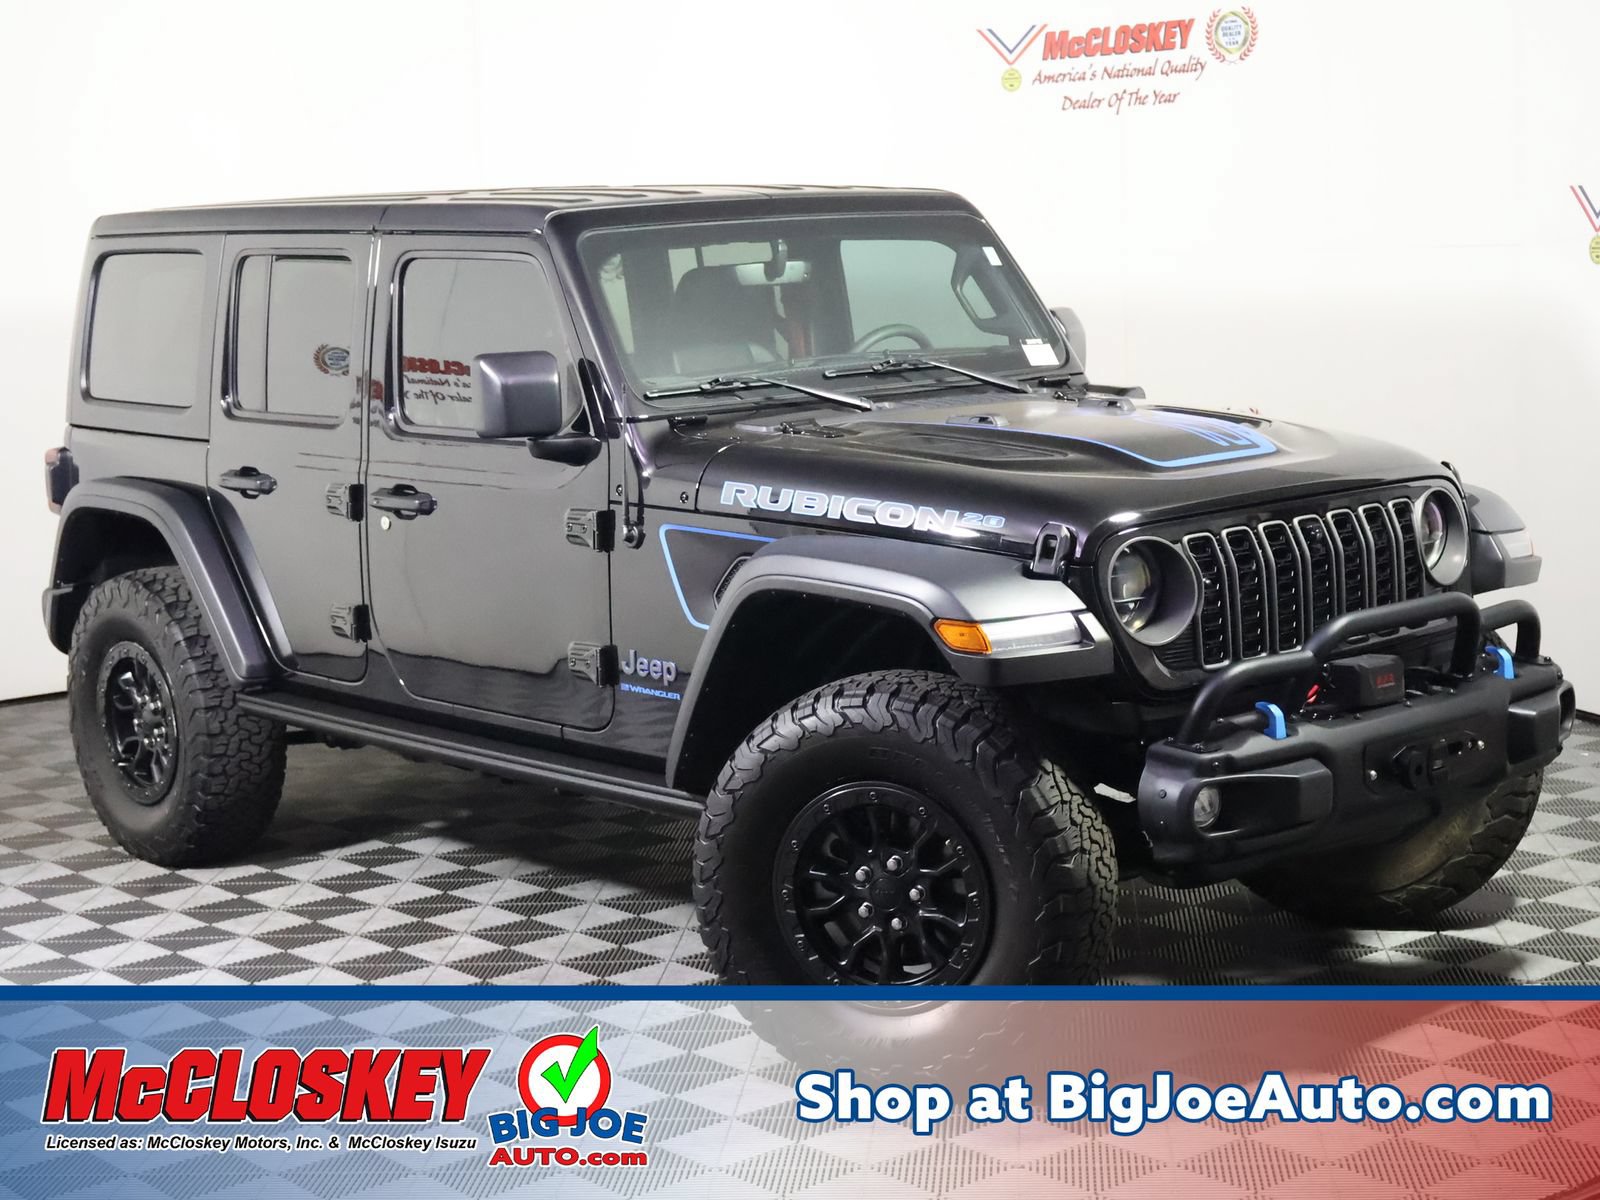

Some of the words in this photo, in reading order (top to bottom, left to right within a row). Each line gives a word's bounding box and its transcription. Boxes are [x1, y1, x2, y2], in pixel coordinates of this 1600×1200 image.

[1042, 18, 1195, 61] McCLOSKEY
[1032, 63, 1097, 86] America's
[1101, 57, 1159, 80] National
[1160, 55, 1207, 81] Quality
[1061, 91, 1105, 111] Dealer
[1128, 88, 1149, 106] The
[1152, 90, 1181, 105] Year
[720, 480, 960, 532] RUBICON
[961, 511, 1006, 528] 20
[621, 648, 677, 686] Jeep
[629, 684, 680, 700] WRANGLER
